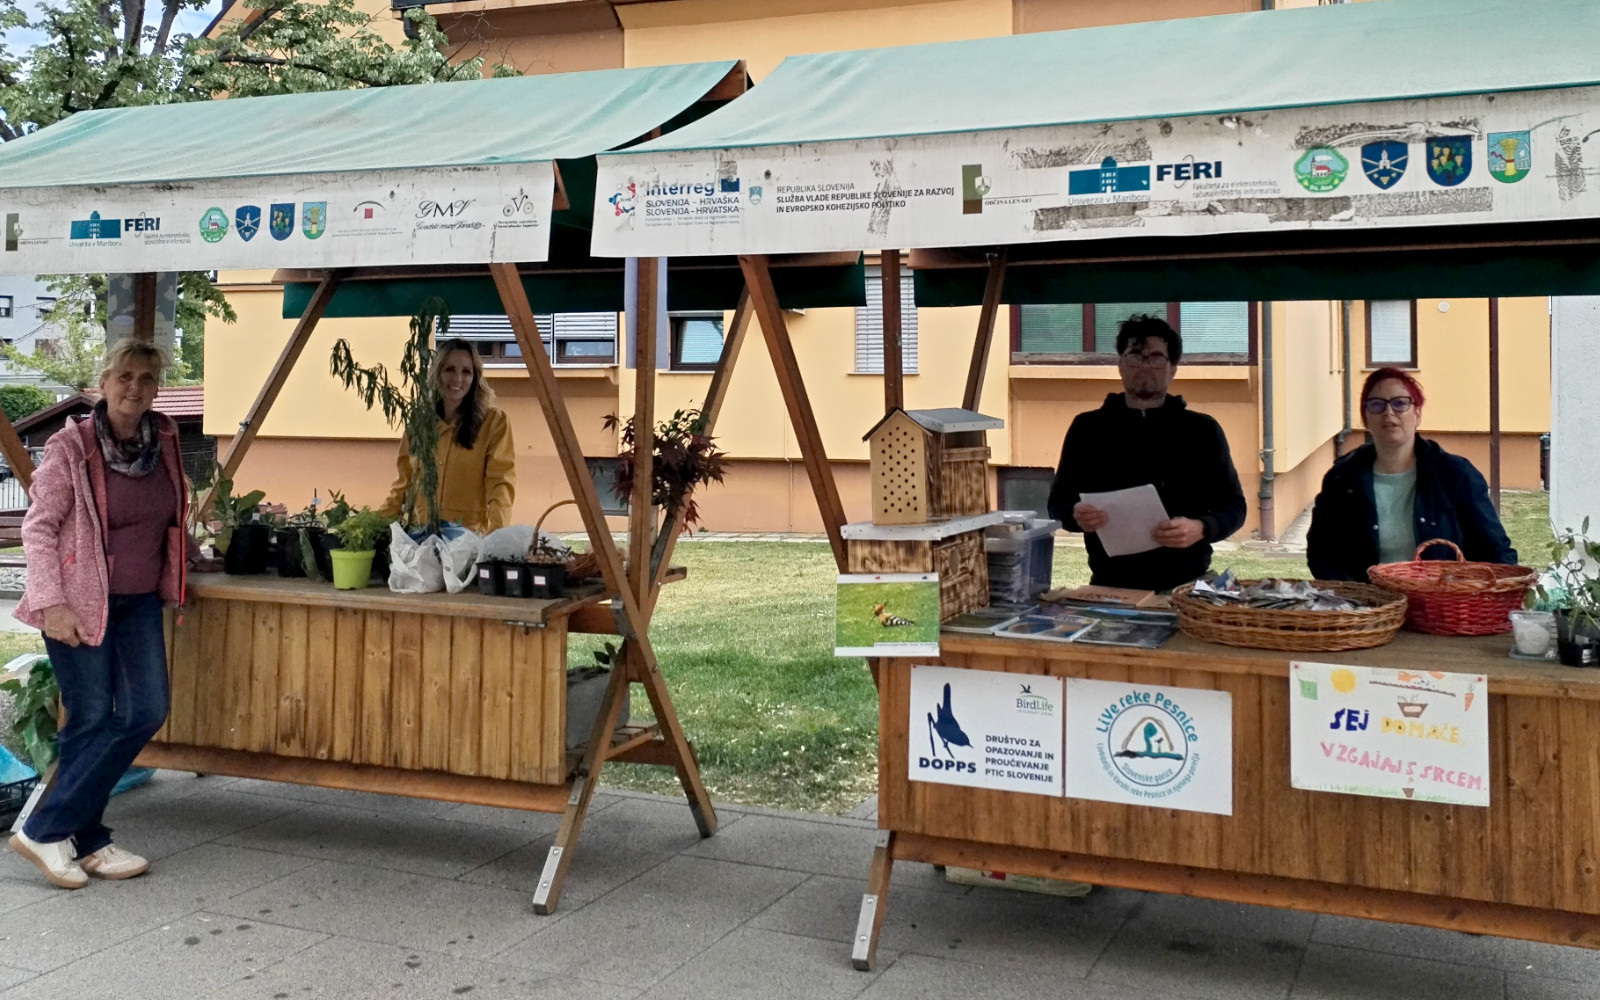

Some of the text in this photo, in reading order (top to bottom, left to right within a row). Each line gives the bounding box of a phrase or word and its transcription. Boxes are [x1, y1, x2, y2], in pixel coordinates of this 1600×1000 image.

[1156, 160, 1222, 182] FERI
[777, 182, 855, 194] REPUBLIKA SLOVENIJA
[777, 187, 955, 203] SLUŽBA VLADE REPUBLIKE SLOVENIJE ZA RAZVOJ
[646, 198, 690, 208] SLOVENIJA
[699, 195, 740, 205] HRVAŠKA
[777, 200, 906, 213] IN EVROPSKO KOHEZIJSKO POLITIKO
[1068, 196, 1104, 206] Univerza
[415, 198, 477, 219] GMV
[646, 207, 690, 217] SLOVENIJA
[696, 205, 740, 215] HRVATSKA
[124, 217, 160, 232] FERI
[1016, 698, 1054, 711] BirdLife
[1119, 690, 1151, 708] reke
[1154, 692, 1198, 742] Pesnice
[1329, 708, 1370, 731] SEJ
[985, 734, 1041, 748] DRUŠTVO ZA
[985, 746, 1054, 761] OPAZOVANJE IN
[919, 757, 977, 774] DOPPS
[985, 757, 1049, 771] PROUČEVANJE
[1405, 761, 1417, 775] S
[985, 768, 1054, 783] PTIC SLOVENIJE
